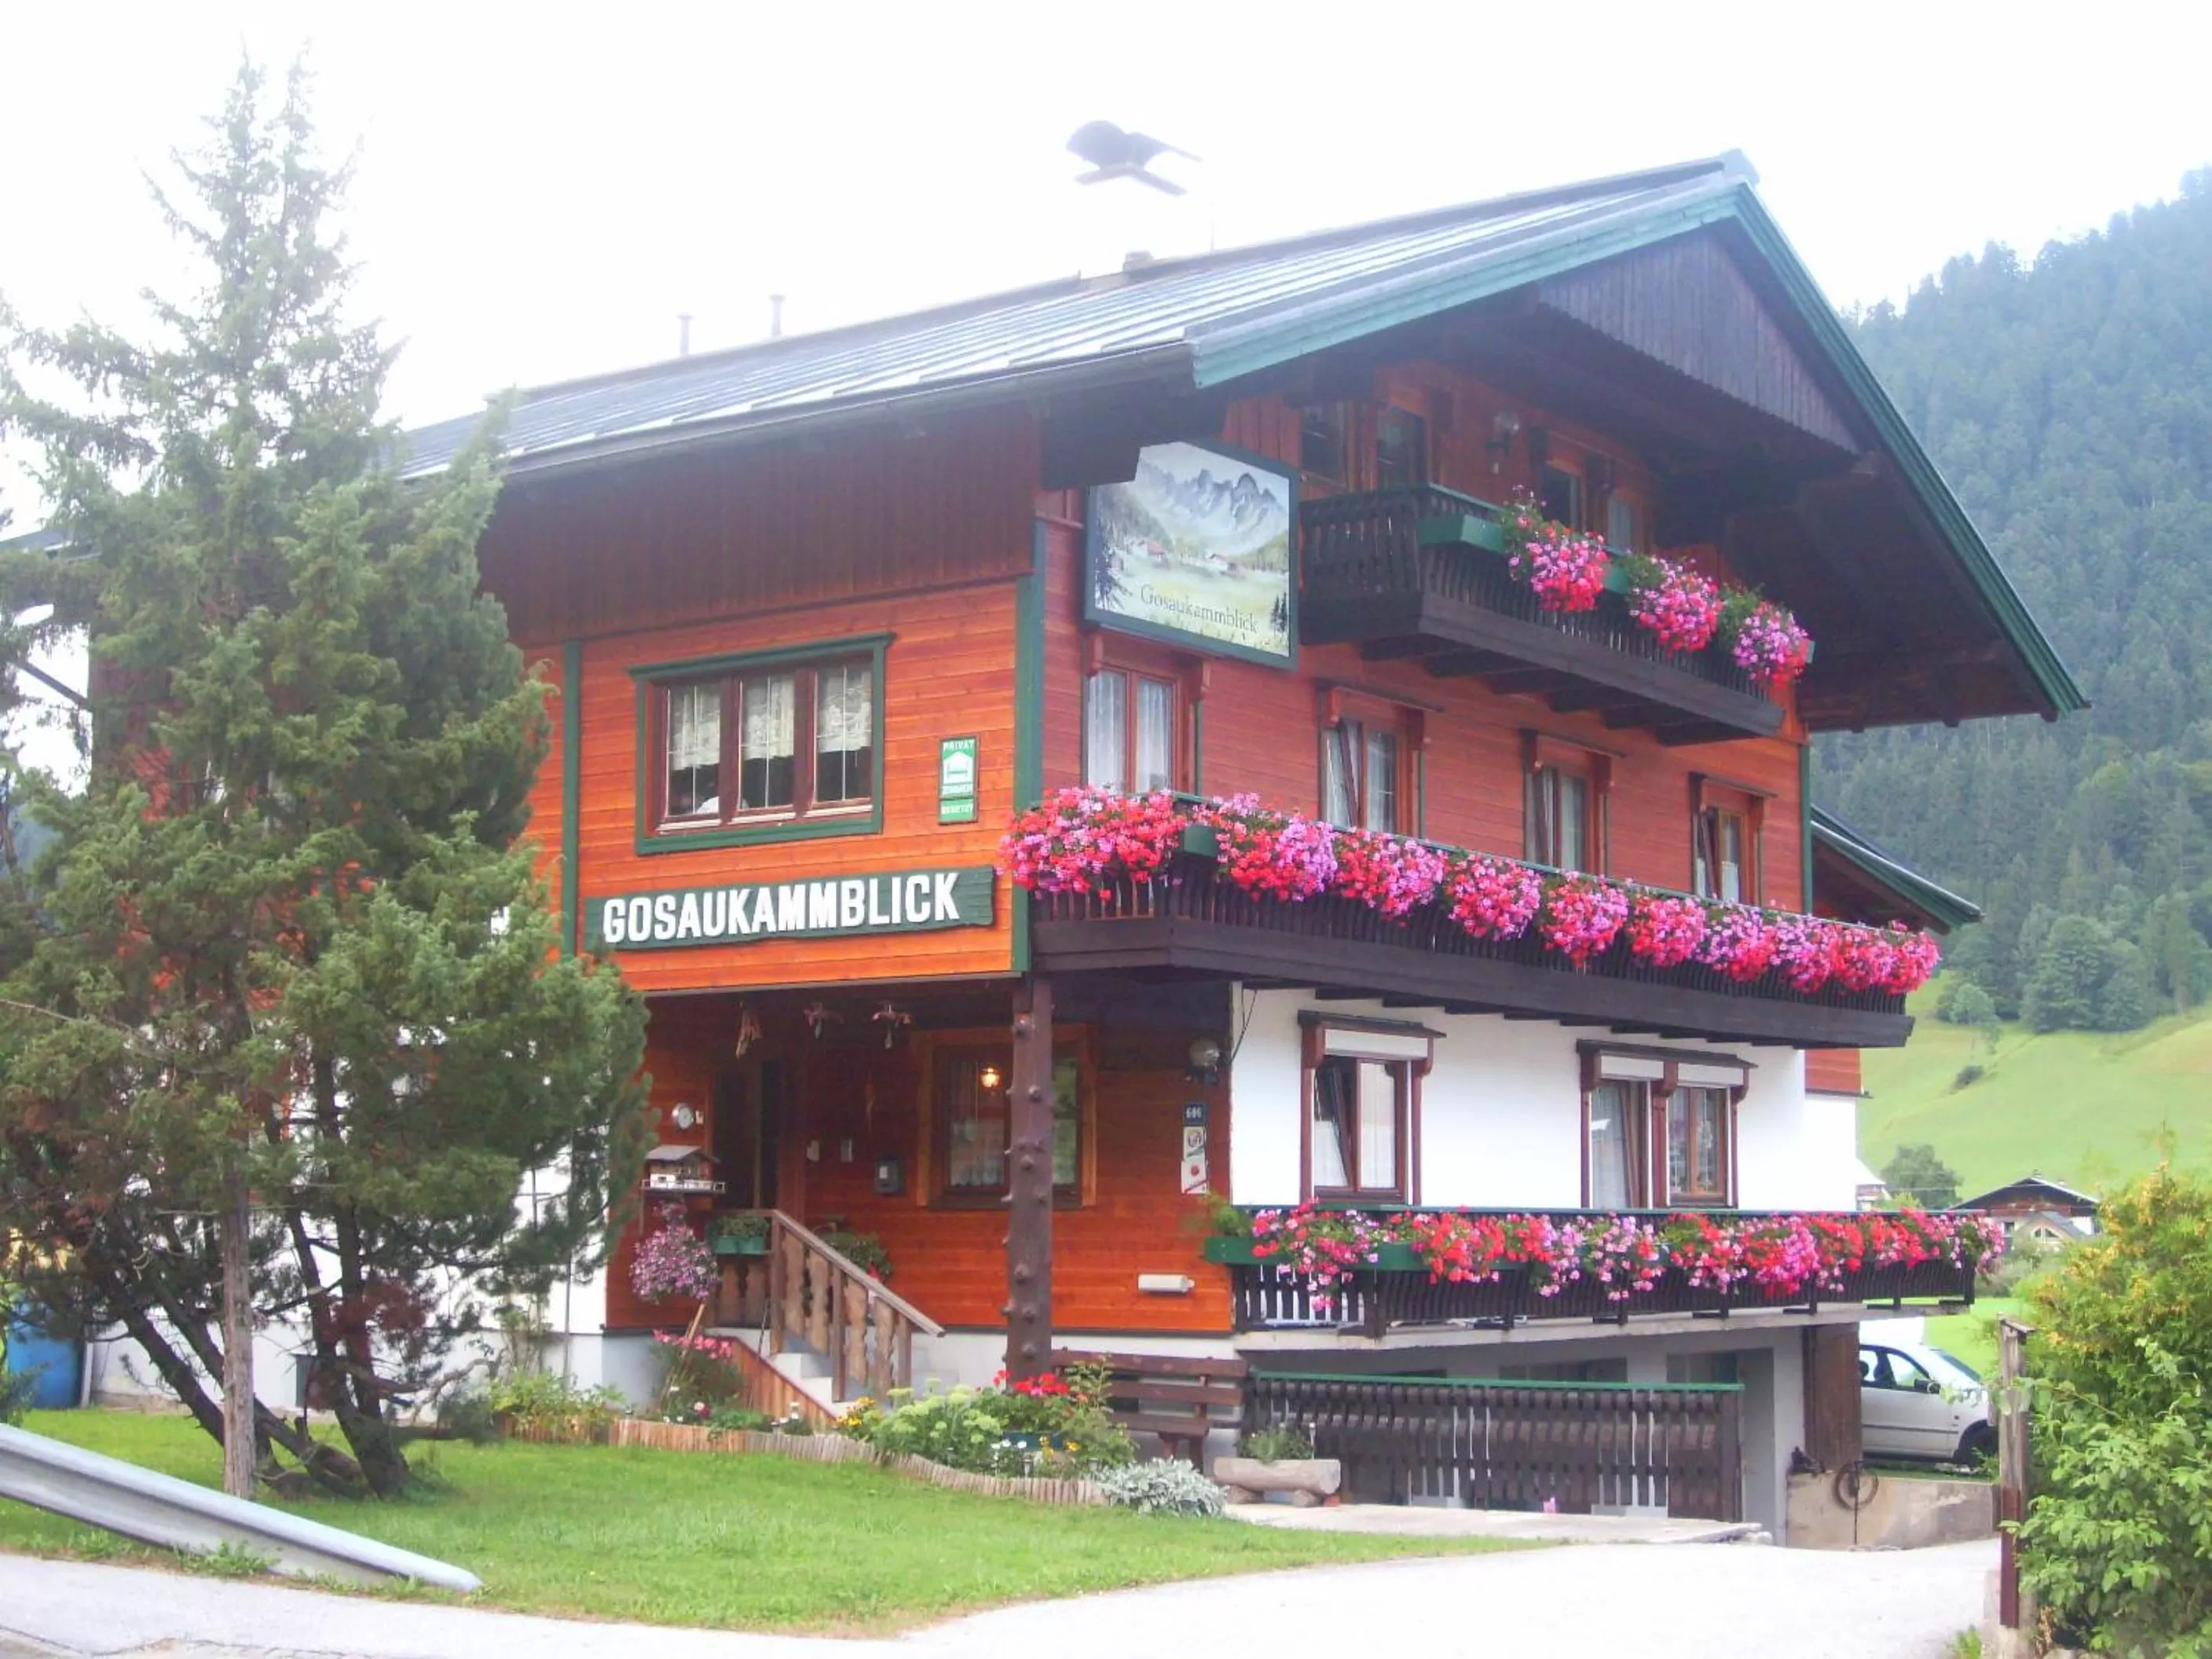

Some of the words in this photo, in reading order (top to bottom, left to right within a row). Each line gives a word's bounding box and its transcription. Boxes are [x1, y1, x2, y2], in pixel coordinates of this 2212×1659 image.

[1140, 583, 1258, 635] Gosaukammblick
[943, 739, 974, 752] PRIVAT
[602, 872, 961, 943] GOSAUKAMMBLICK
